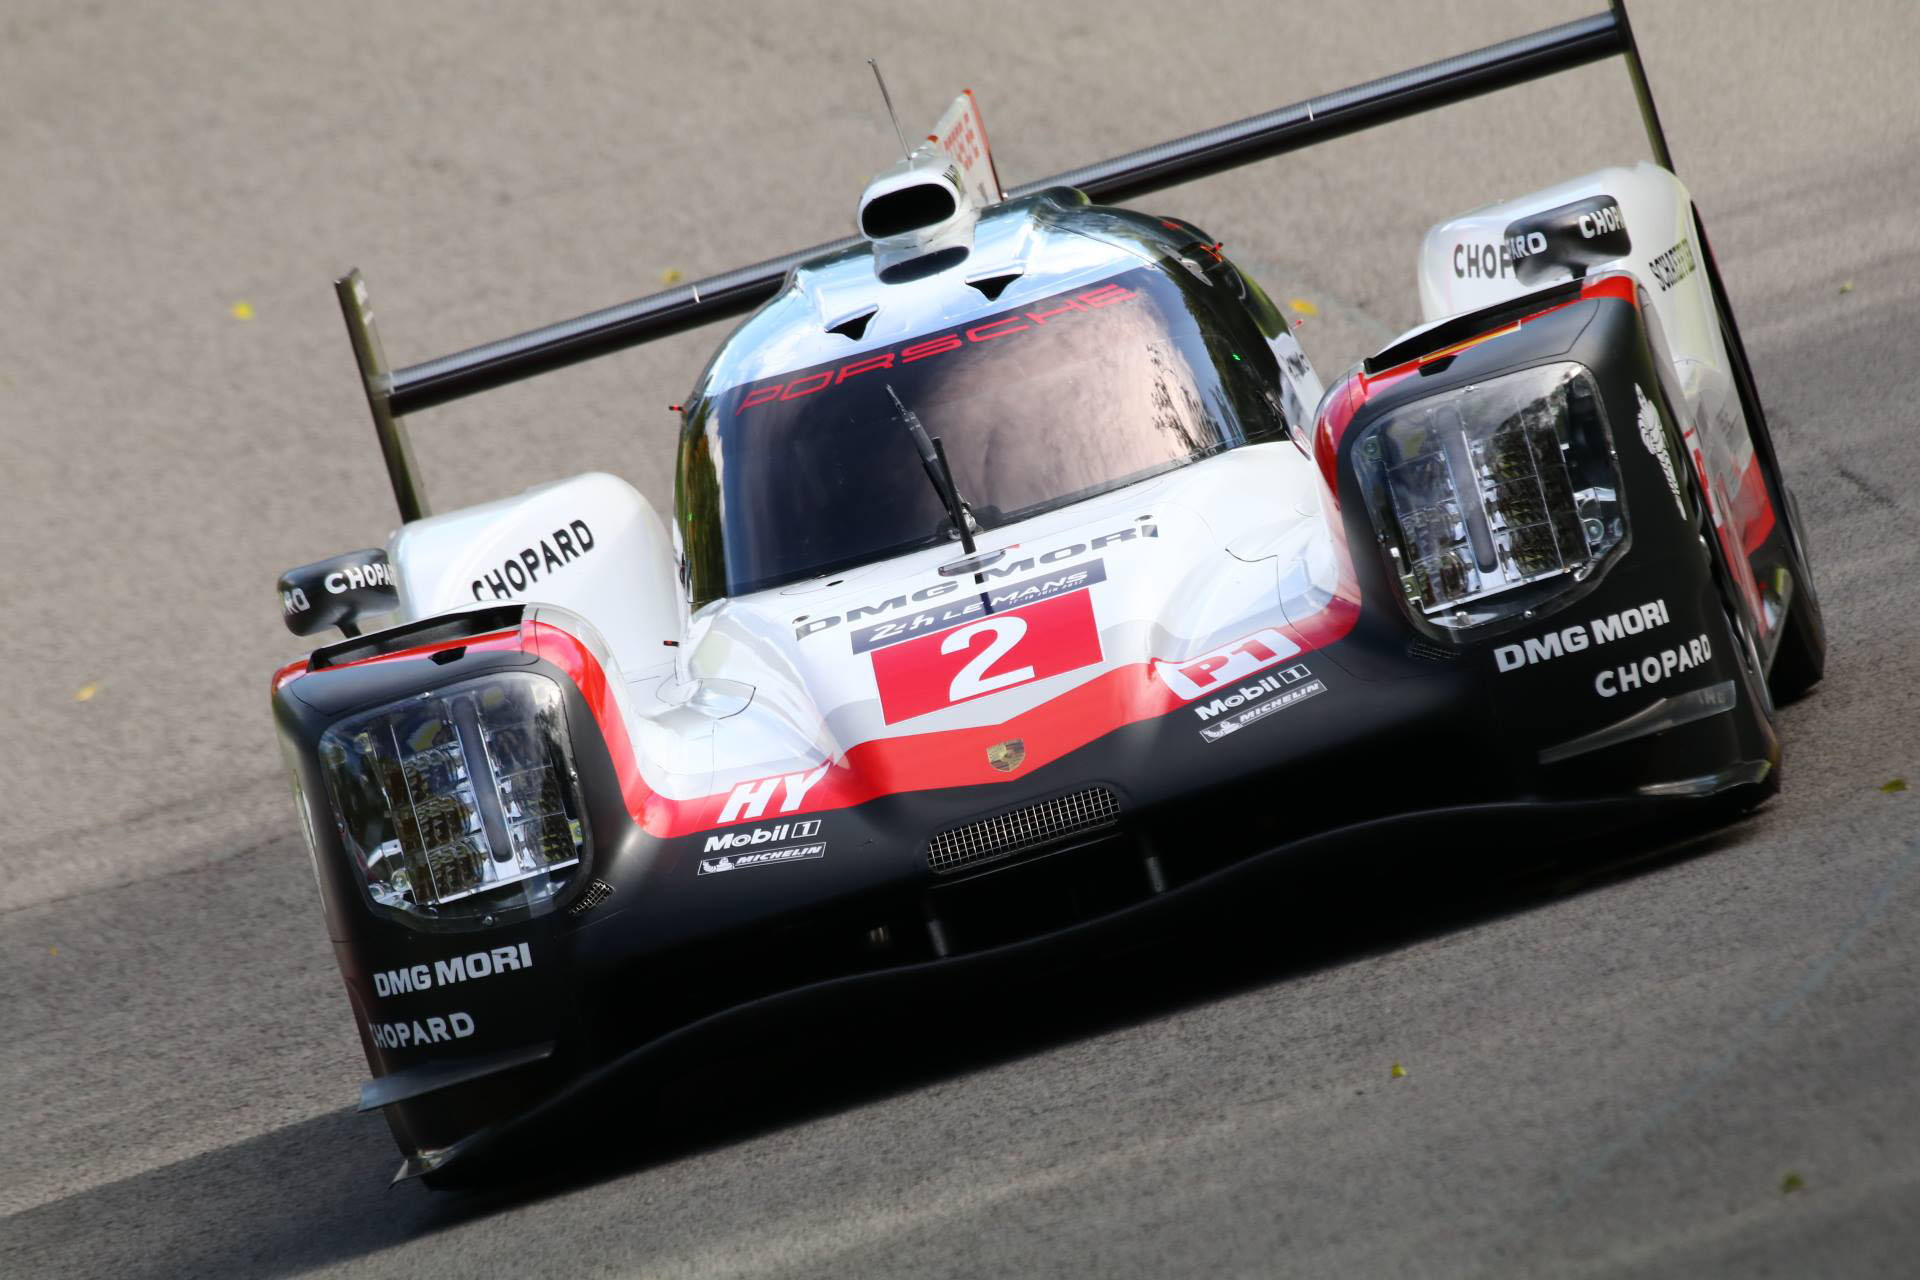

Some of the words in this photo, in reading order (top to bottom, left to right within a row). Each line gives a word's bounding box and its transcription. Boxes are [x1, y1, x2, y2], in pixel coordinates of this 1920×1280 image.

[1453, 243, 1516, 279] CHOP
[736, 283, 1139, 416] PORSCHE
[472, 519, 595, 602] CHOPARD
[795, 580, 959, 641] DMG
[943, 601, 985, 621] LE
[990, 571, 1088, 607] MANS
[940, 615, 1036, 702] 2
[1178, 639, 1277, 688] P1
[1493, 625, 1590, 673] DMG
[1590, 599, 1670, 645] MORI
[1595, 634, 1712, 698] CHOPARD
[1194, 675, 1282, 721] Mobil
[1239, 683, 1320, 723] MICHELIN
[716, 762, 831, 824] HY
[703, 823, 790, 853] Mobil
[736, 845, 823, 865] MICHELIN
[373, 964, 432, 998] DMG
[434, 942, 533, 987] MORI
